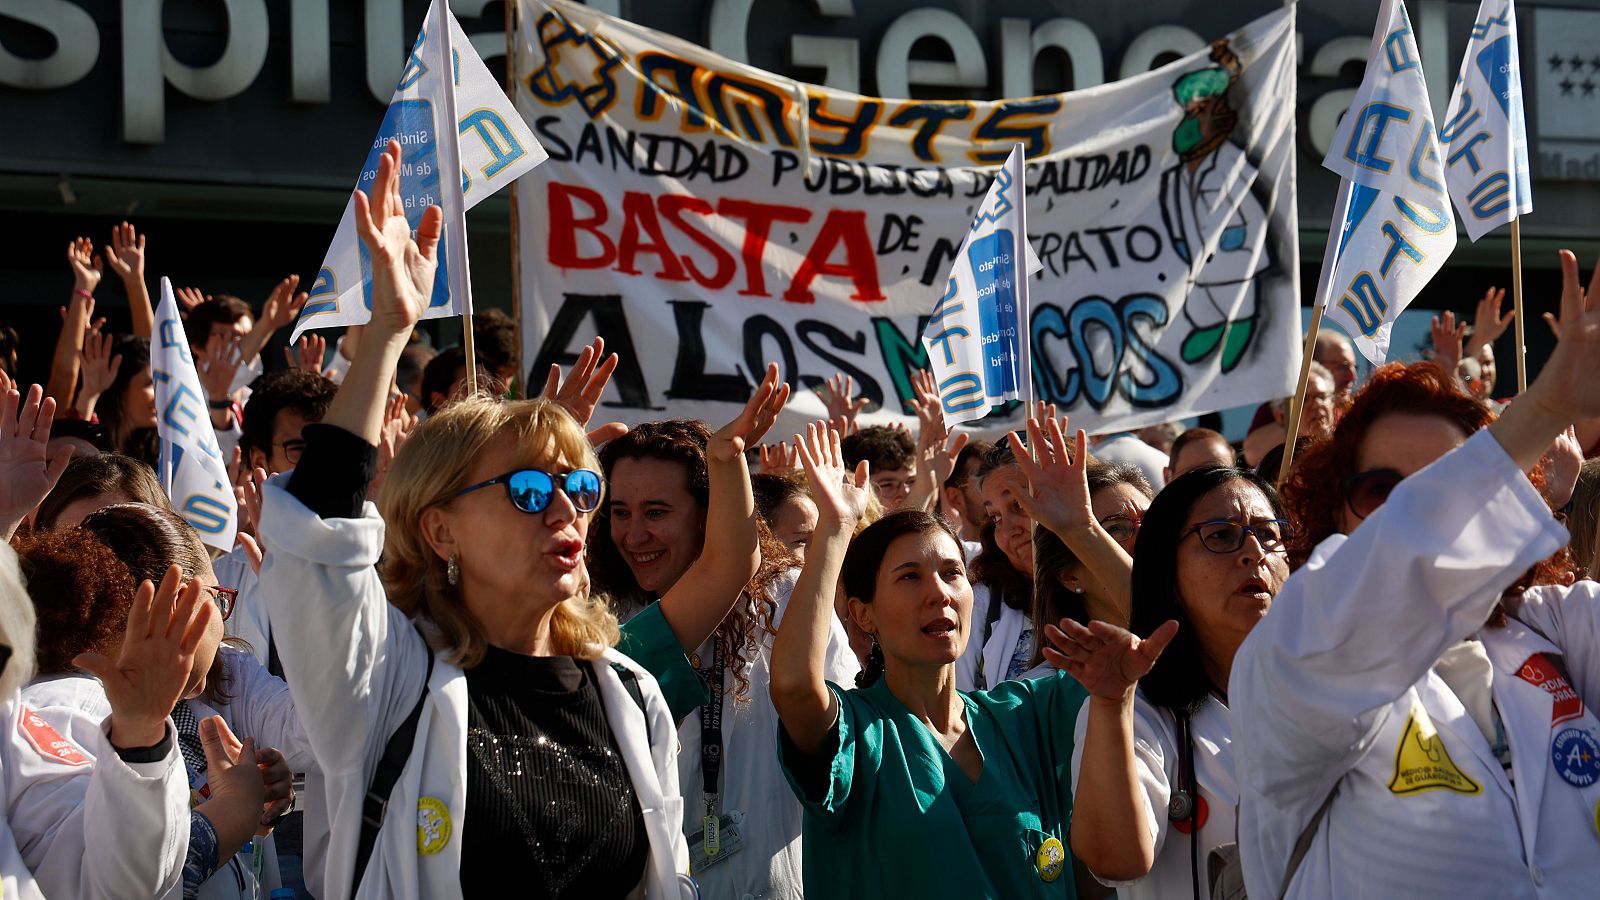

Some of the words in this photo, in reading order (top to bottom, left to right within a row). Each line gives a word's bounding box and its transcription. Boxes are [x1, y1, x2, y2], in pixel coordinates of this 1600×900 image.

[535, 115, 750, 183] SANIDAD
[771, 149, 953, 199] PUBLICA
[1026, 144, 1152, 197] CALIDAD
[635, 49, 1063, 165] AMYTS
[546, 181, 888, 304] BASTA
[877, 213, 922, 255] DE
[526, 292, 666, 411] A
[664, 300, 884, 414] LOS
[870, 293, 1183, 416] MCOS
